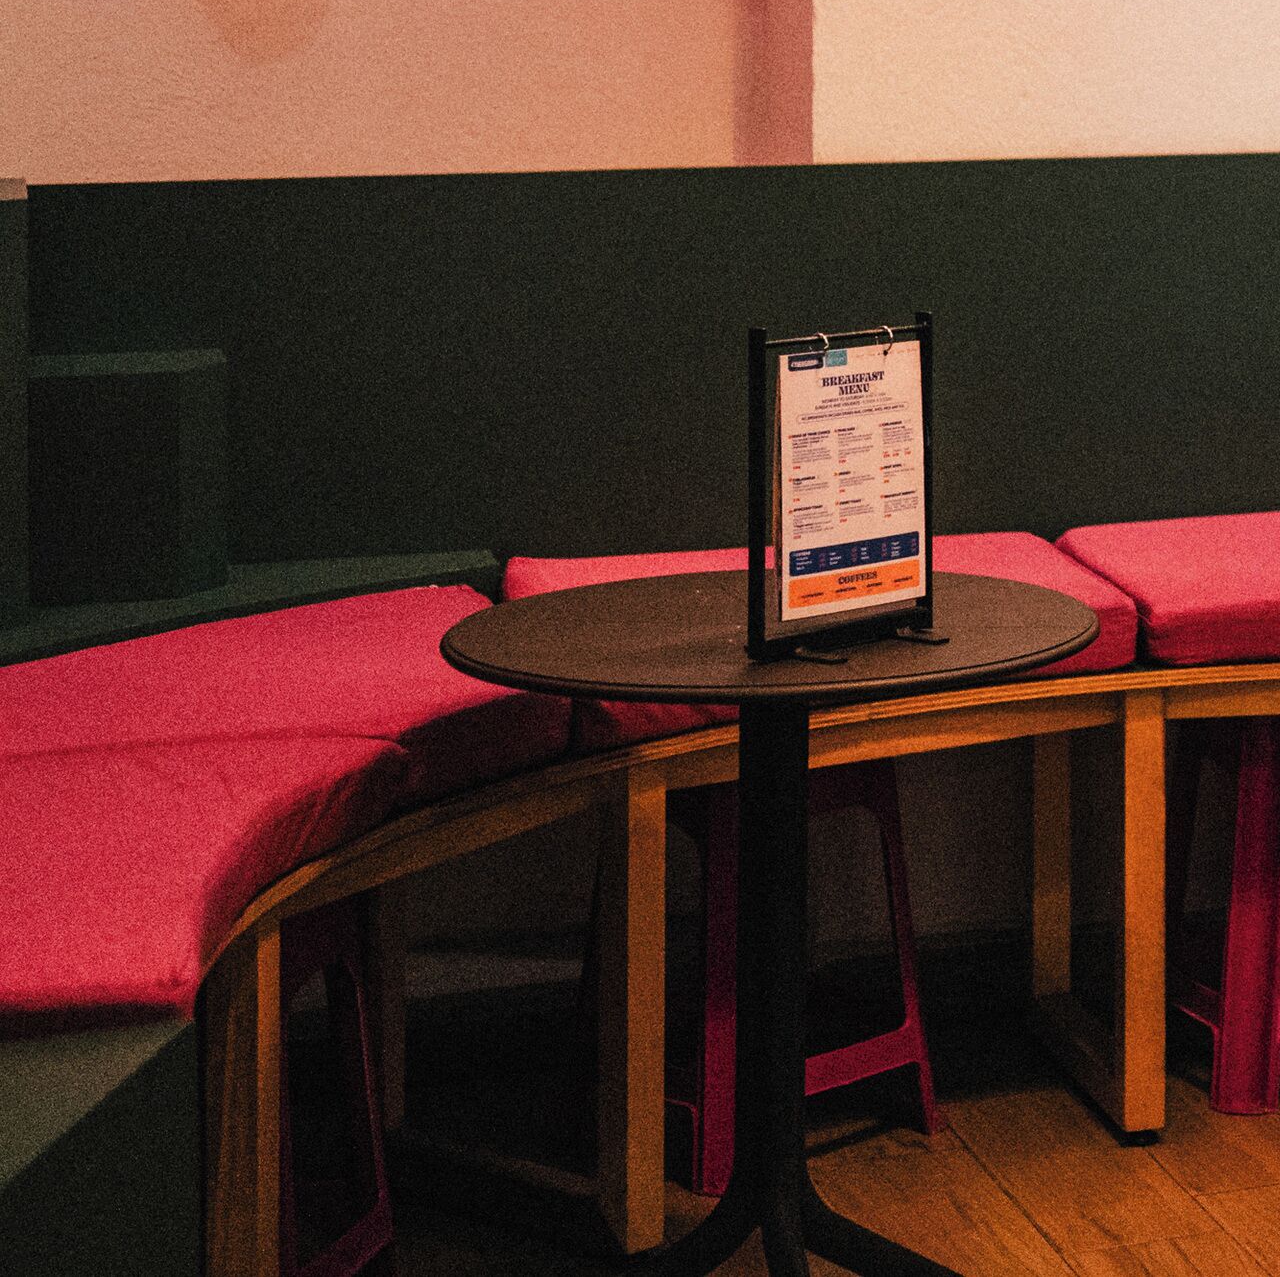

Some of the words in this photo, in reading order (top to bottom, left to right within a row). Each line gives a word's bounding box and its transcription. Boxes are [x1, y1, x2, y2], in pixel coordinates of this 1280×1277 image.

[822, 371, 885, 387] BREAKFAST
[839, 383, 870, 395] MENU
[838, 571, 877, 584] COFFEES
